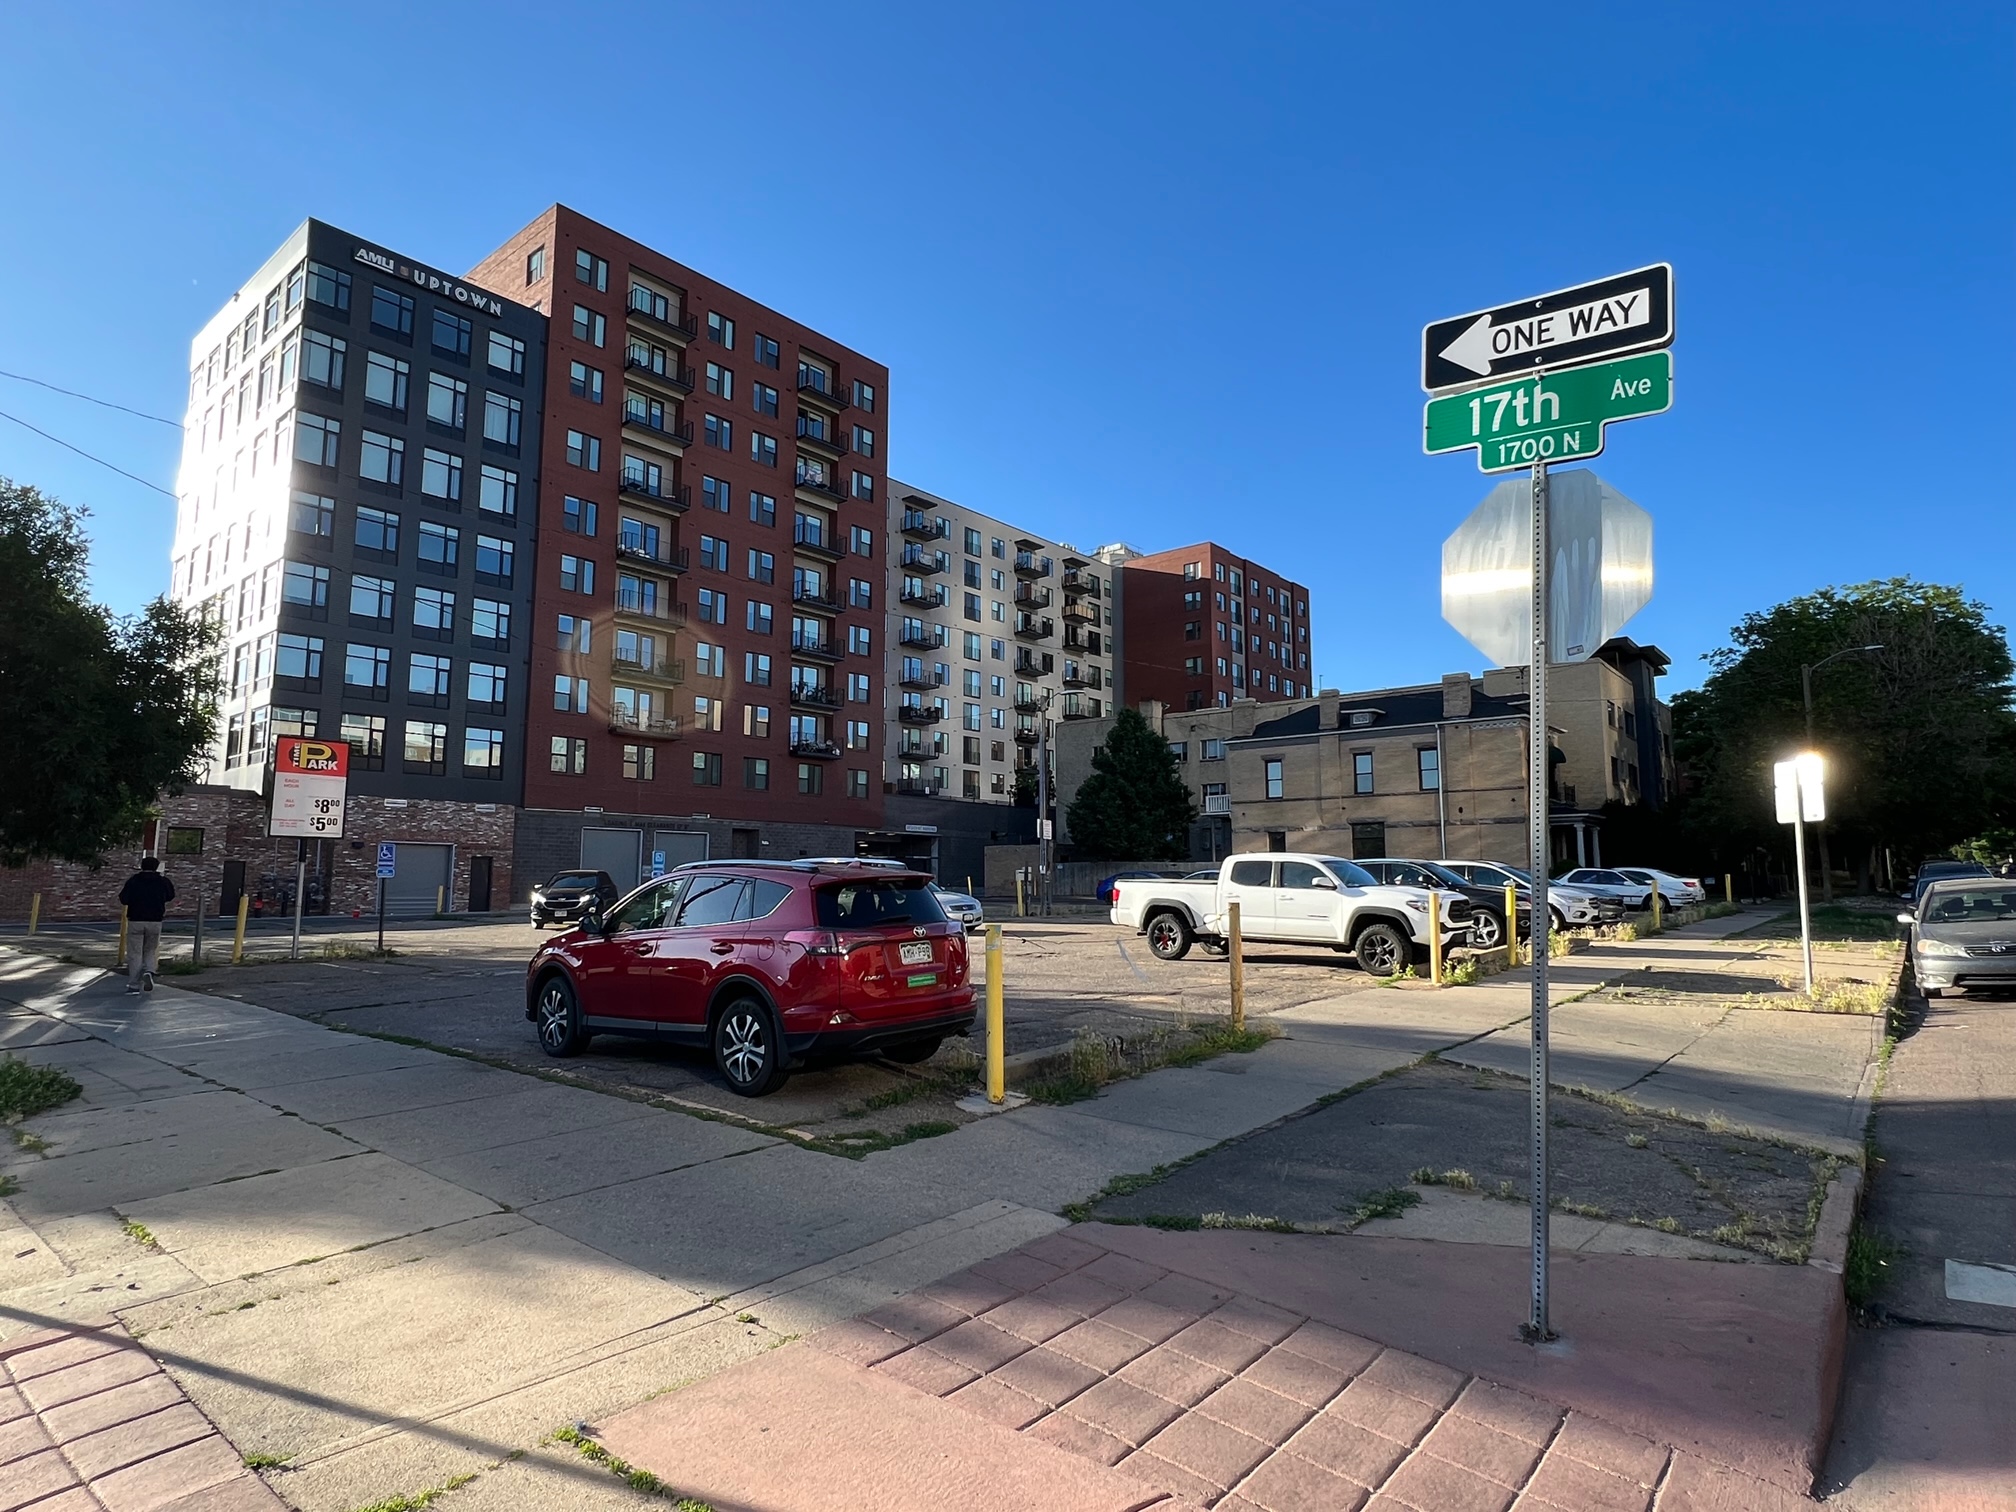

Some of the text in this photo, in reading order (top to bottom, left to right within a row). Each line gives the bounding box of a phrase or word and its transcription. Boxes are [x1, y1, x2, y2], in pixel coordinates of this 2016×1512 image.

[356, 248, 502, 317] AMLI UPTOWN
[1492, 294, 1640, 355] ONE WAY
[1468, 377, 1652, 437] 17th Ave
[1498, 430, 1580, 464] 1700 N
[299, 742, 339, 771] PARK
